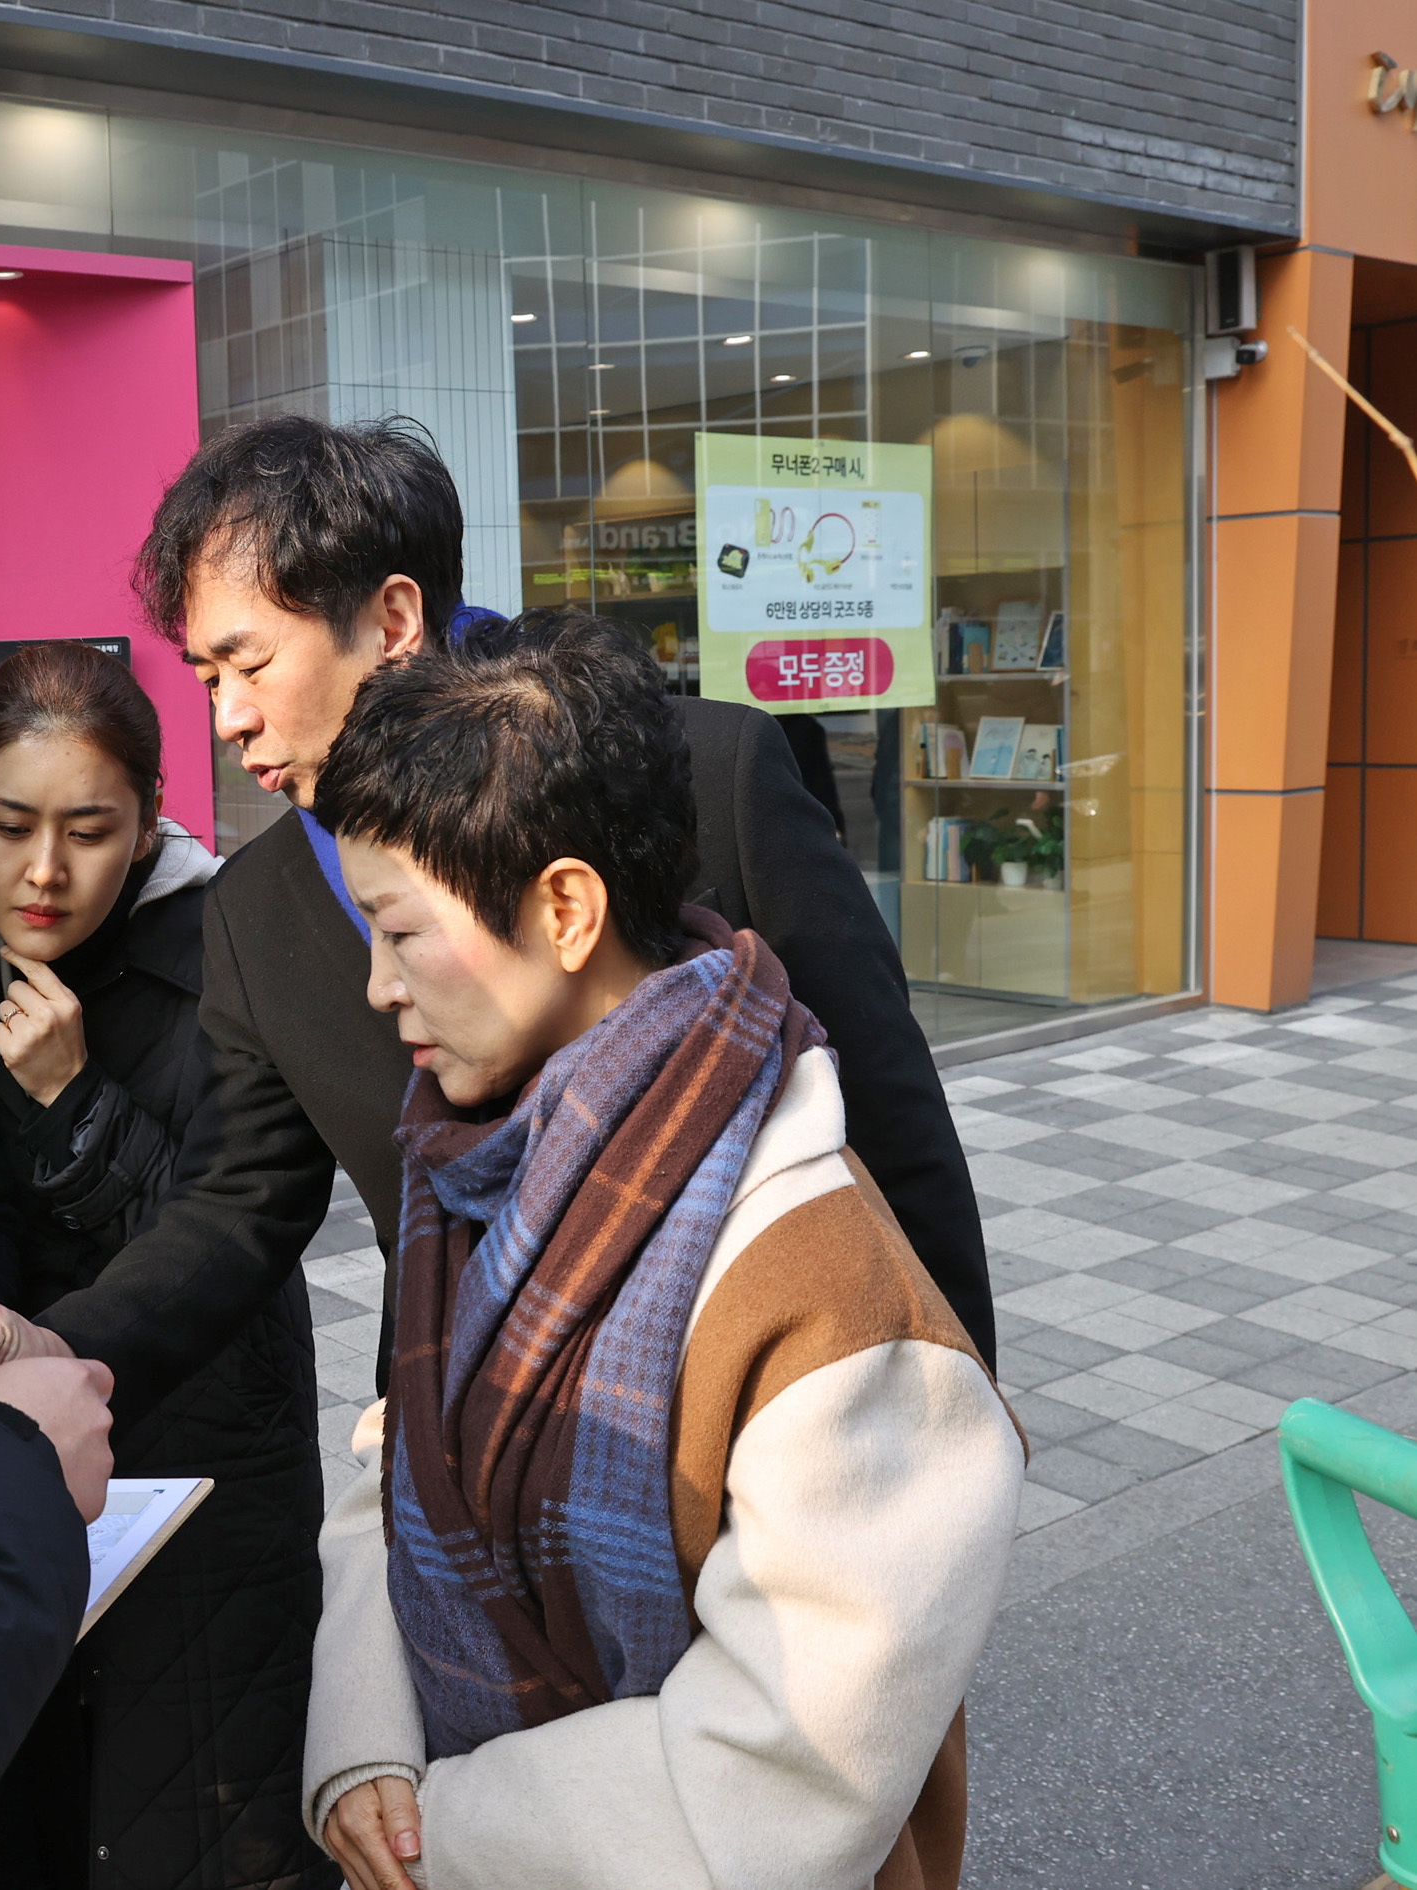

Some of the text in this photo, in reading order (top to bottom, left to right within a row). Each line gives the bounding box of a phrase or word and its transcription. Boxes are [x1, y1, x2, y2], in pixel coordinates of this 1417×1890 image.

[771, 453, 820, 477] 무너폰2
[822, 455, 847, 478] 구매
[766, 601, 797, 620] 6만원
[834, 600, 856, 619] 굿즈
[857, 600, 875, 619] 5종
